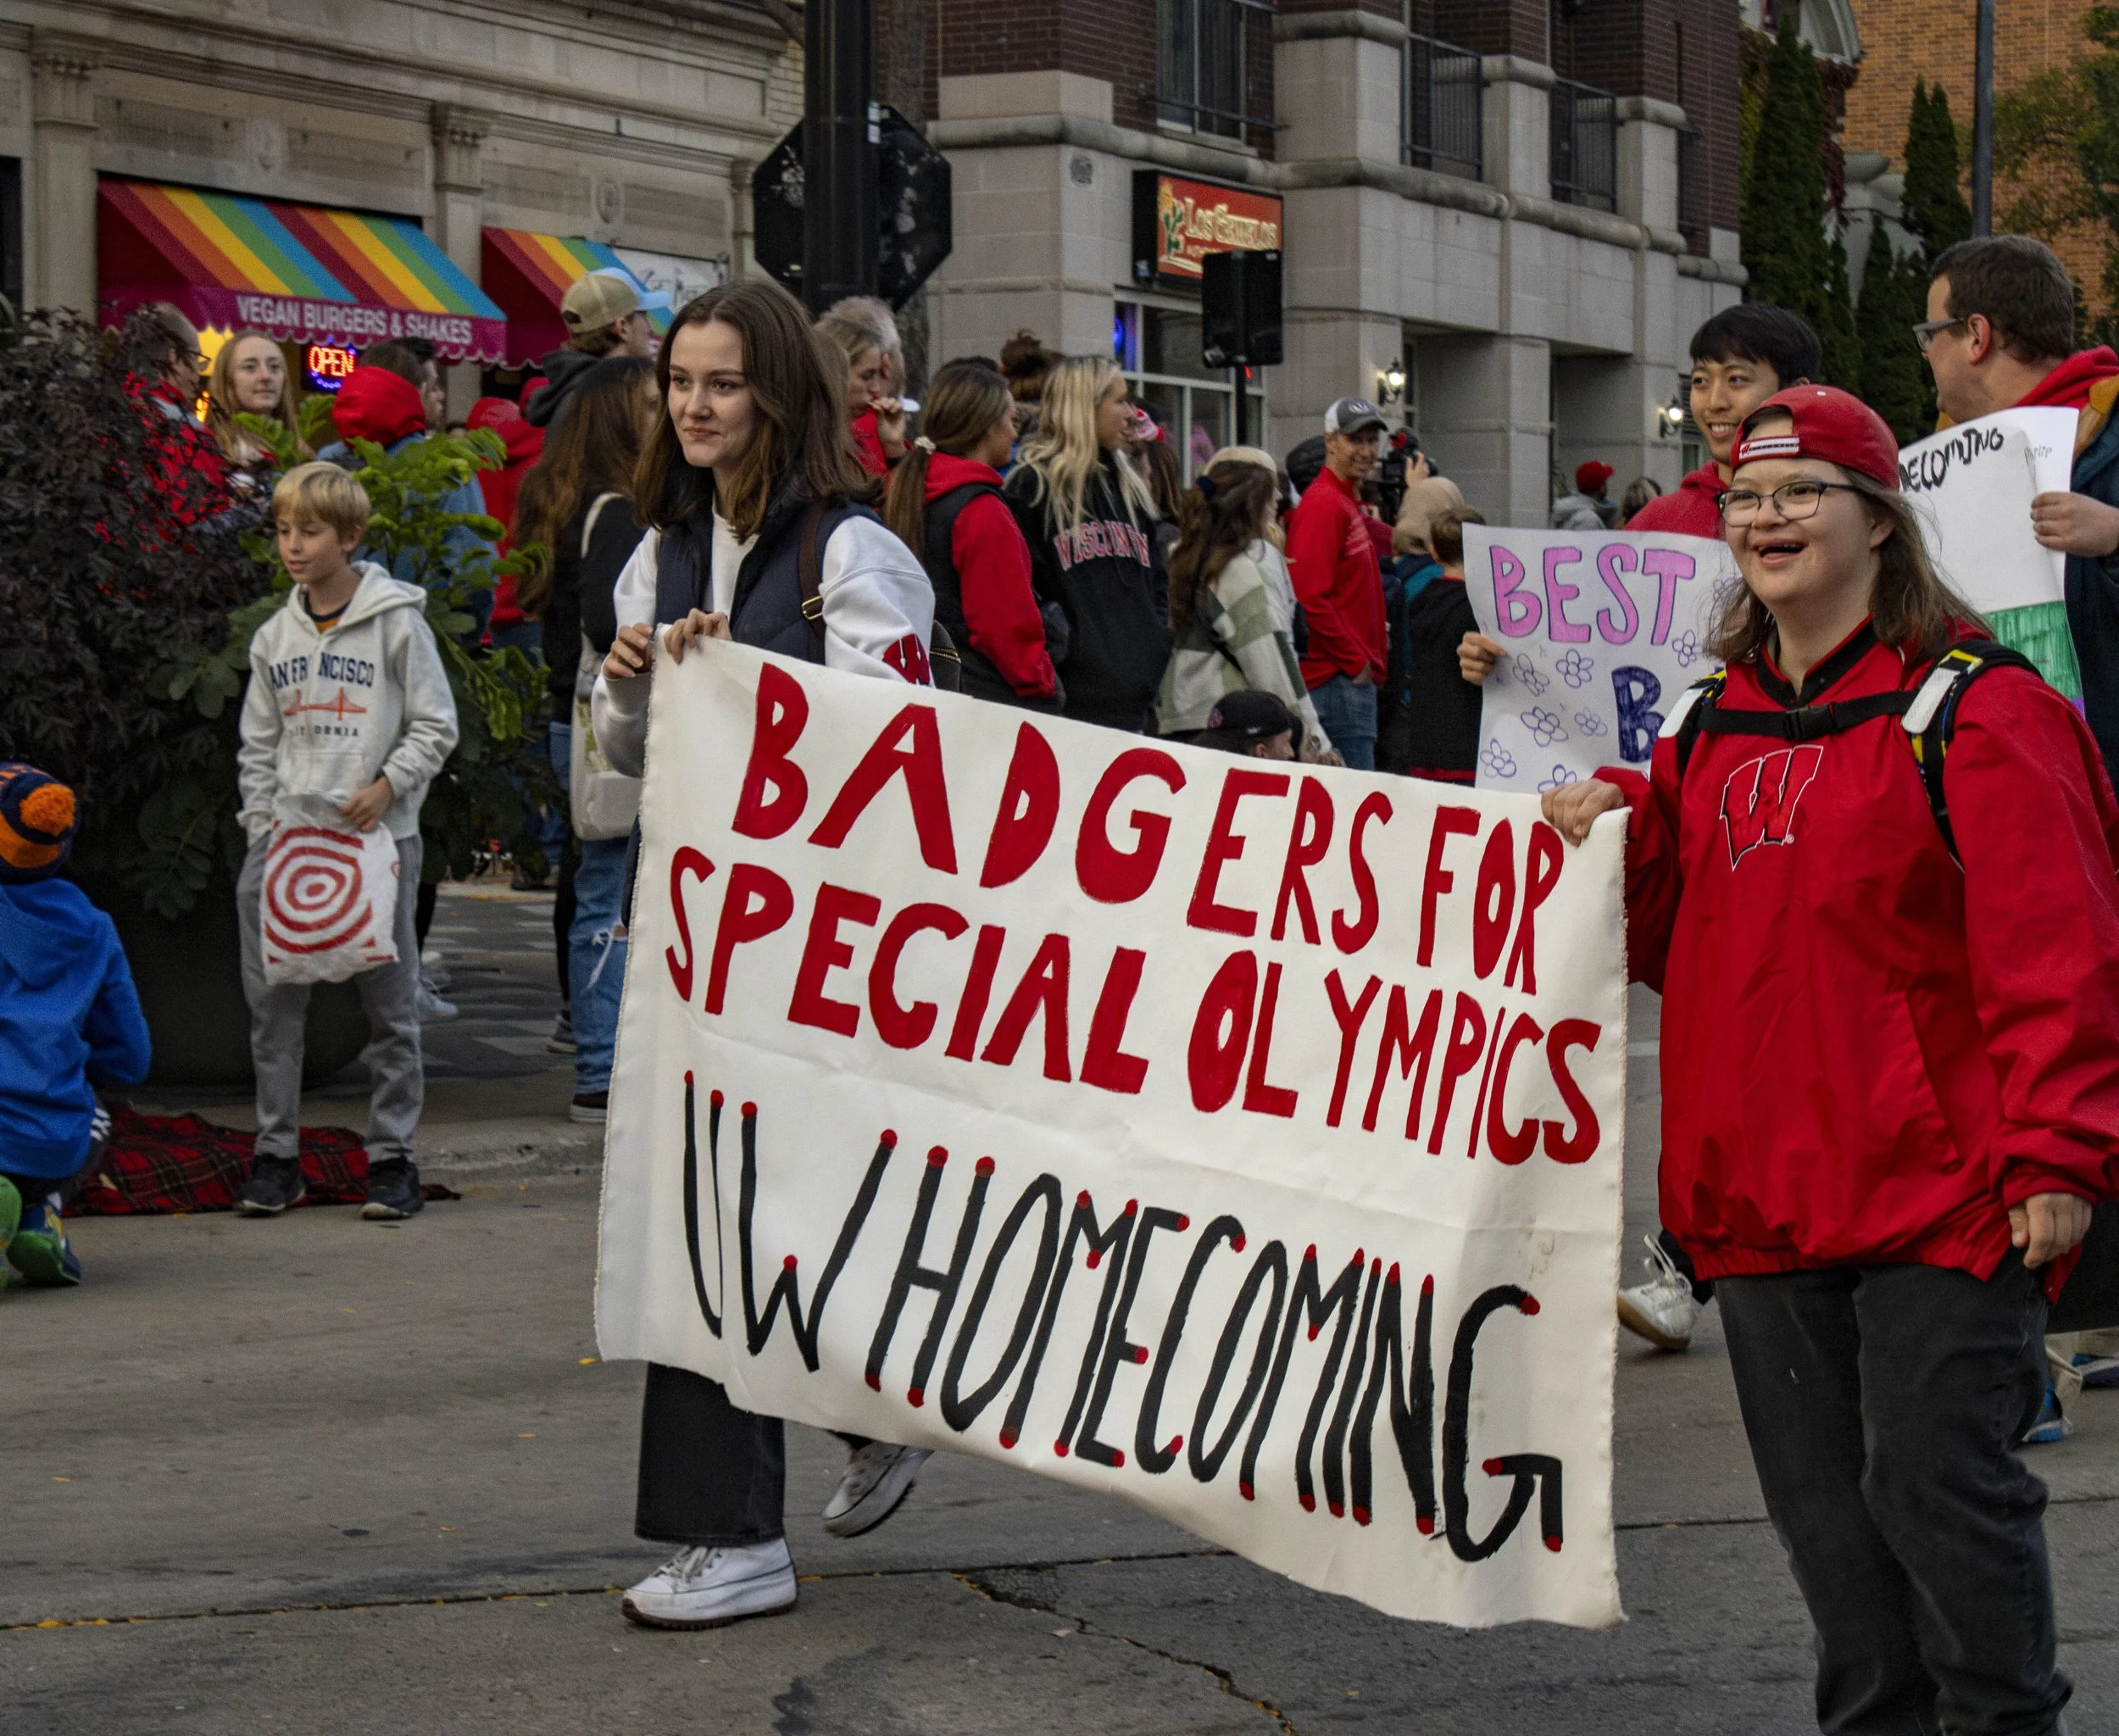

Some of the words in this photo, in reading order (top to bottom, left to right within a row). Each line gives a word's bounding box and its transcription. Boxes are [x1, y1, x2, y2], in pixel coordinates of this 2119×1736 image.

[236, 294, 300, 327] VEGAN
[303, 303, 387, 337] BURGERS
[391, 312, 403, 336] &
[404, 314, 473, 344] SHAKES
[309, 345, 356, 376] OPEN
[1489, 542, 1695, 645] BEST
[291, 651, 375, 688] FRNCISCO
[732, 661, 1393, 954] BADGERS
[1416, 804, 1566, 995] FOR
[1719, 744, 1824, 872] W
[665, 845, 1149, 1094] SPECIAL
[1187, 949, 1601, 1166] OLYMPICS
[683, 1070, 898, 1372] UW
[865, 1144, 1564, 1562] HOMECOMING
